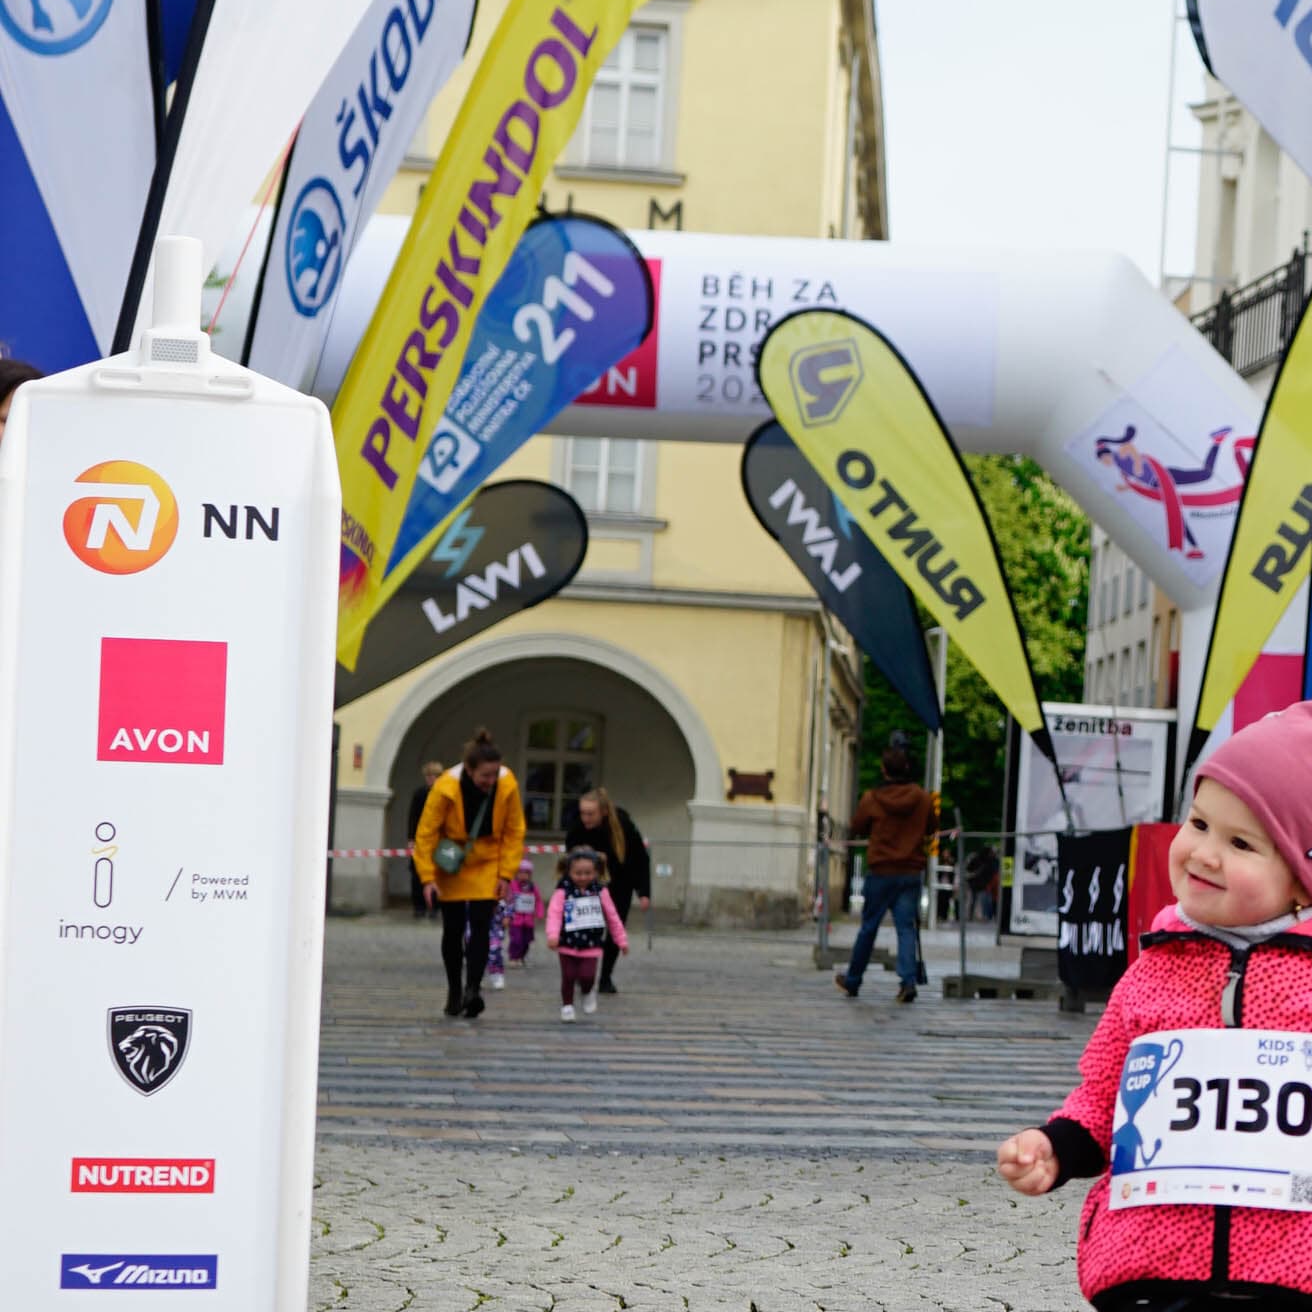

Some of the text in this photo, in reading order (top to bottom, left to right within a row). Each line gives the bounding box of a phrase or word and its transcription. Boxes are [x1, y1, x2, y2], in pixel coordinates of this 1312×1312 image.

[360, 6, 598, 491] PERSKINDOL
[702, 270, 838, 303] BĚH ZA
[513, 250, 614, 365] 211
[202, 503, 280, 542] NN
[110, 727, 210, 753] AVON
[191, 873, 250, 887] Powered
[191, 888, 249, 903] by MVM
[59, 919, 143, 946] innogy
[114, 1012, 184, 1025] PEUGEOT
[1257, 1039, 1295, 1052] KIDS
[1127, 1054, 1157, 1074] KIDS
[1256, 1053, 1290, 1067] CUP
[1125, 1073, 1152, 1092] CUP
[78, 1164, 210, 1188] NUTREND
